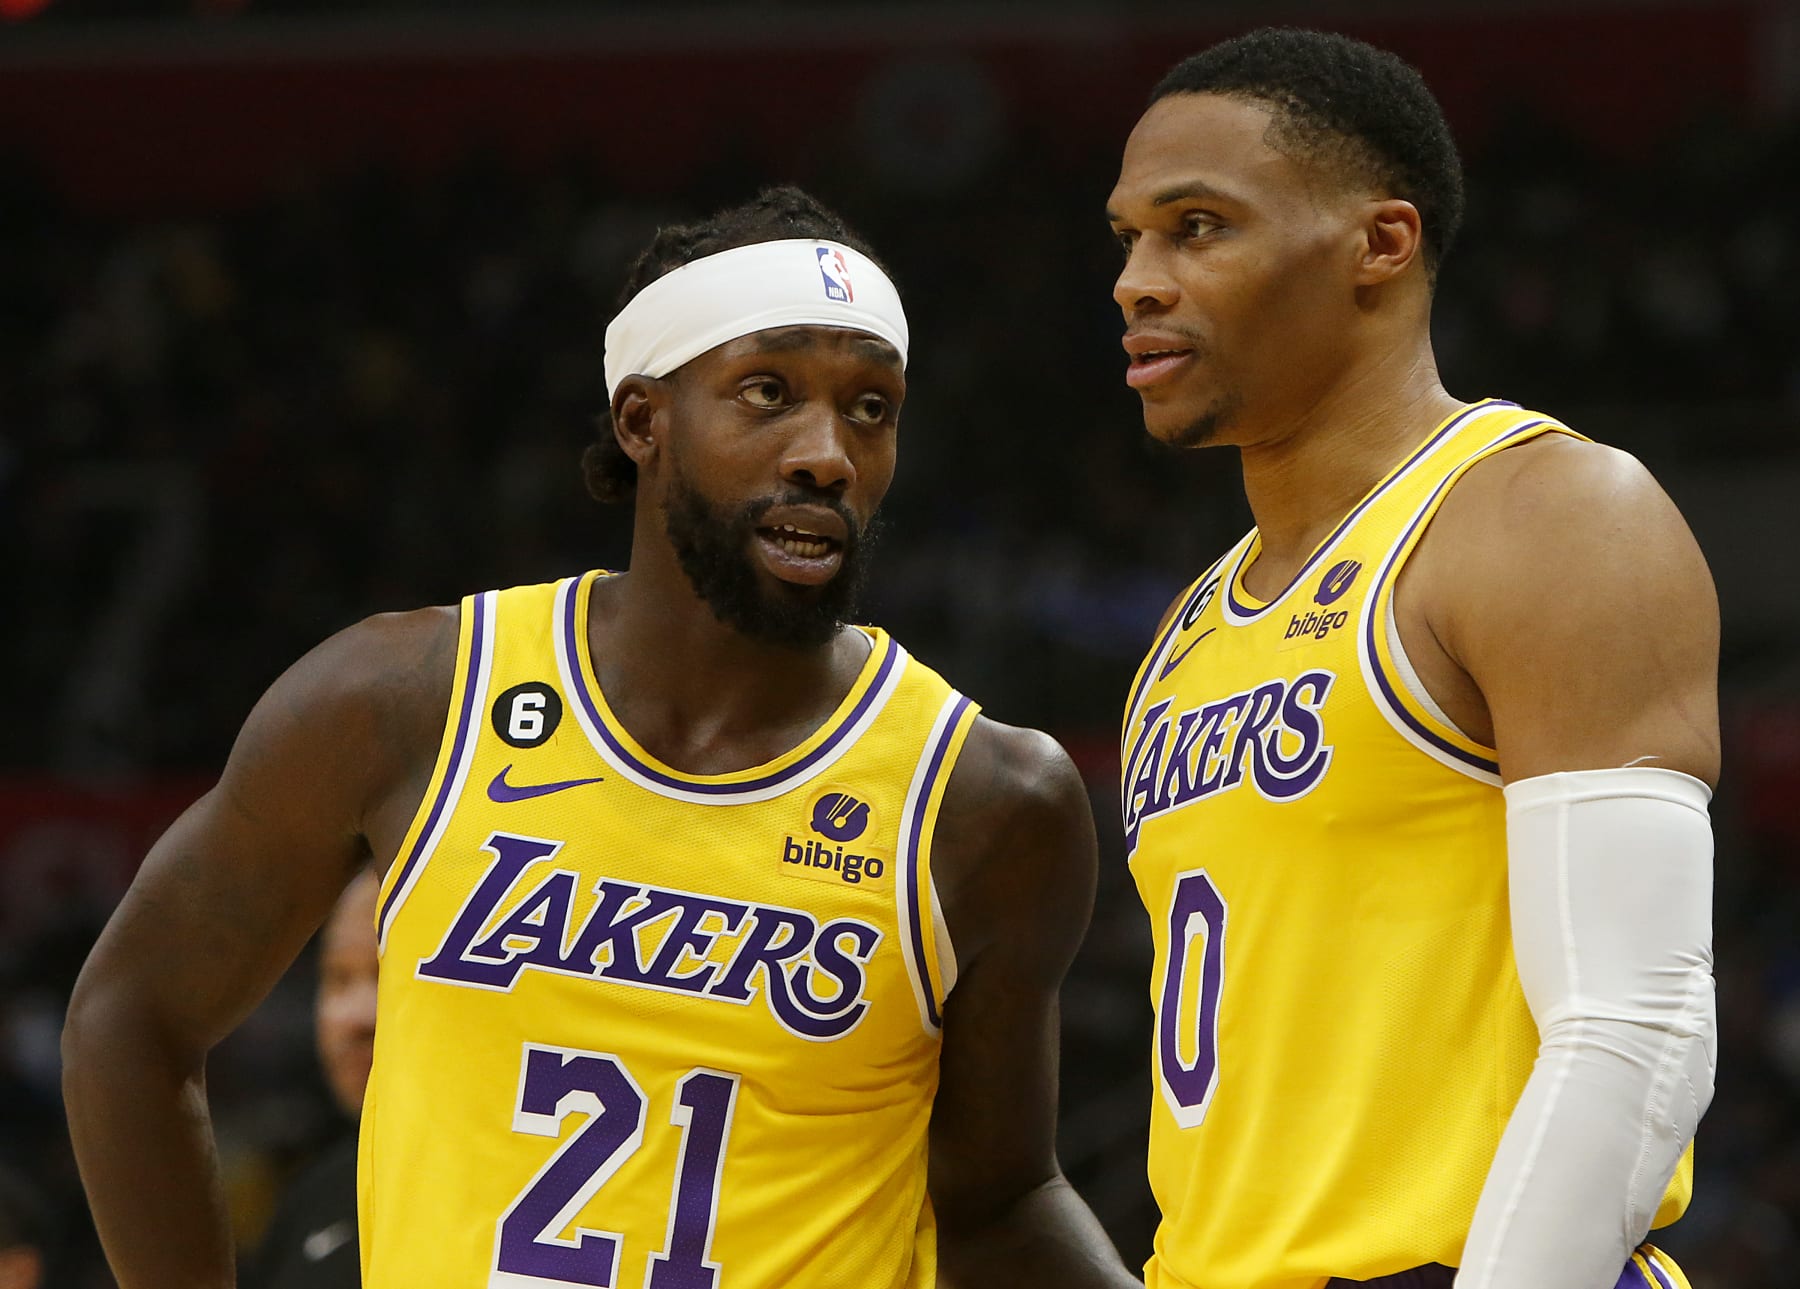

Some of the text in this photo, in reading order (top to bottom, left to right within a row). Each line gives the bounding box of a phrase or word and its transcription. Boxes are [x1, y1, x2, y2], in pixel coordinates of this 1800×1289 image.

[1189, 582, 1218, 623] 6
[1284, 609, 1348, 640] bibigo
[508, 692, 547, 739] 6
[1122, 668, 1337, 860] LAKERS
[783, 837, 884, 882] bibigo
[415, 830, 884, 1043] LAKERS
[1158, 867, 1228, 1130] 0
[487, 1042, 742, 1289] 21
